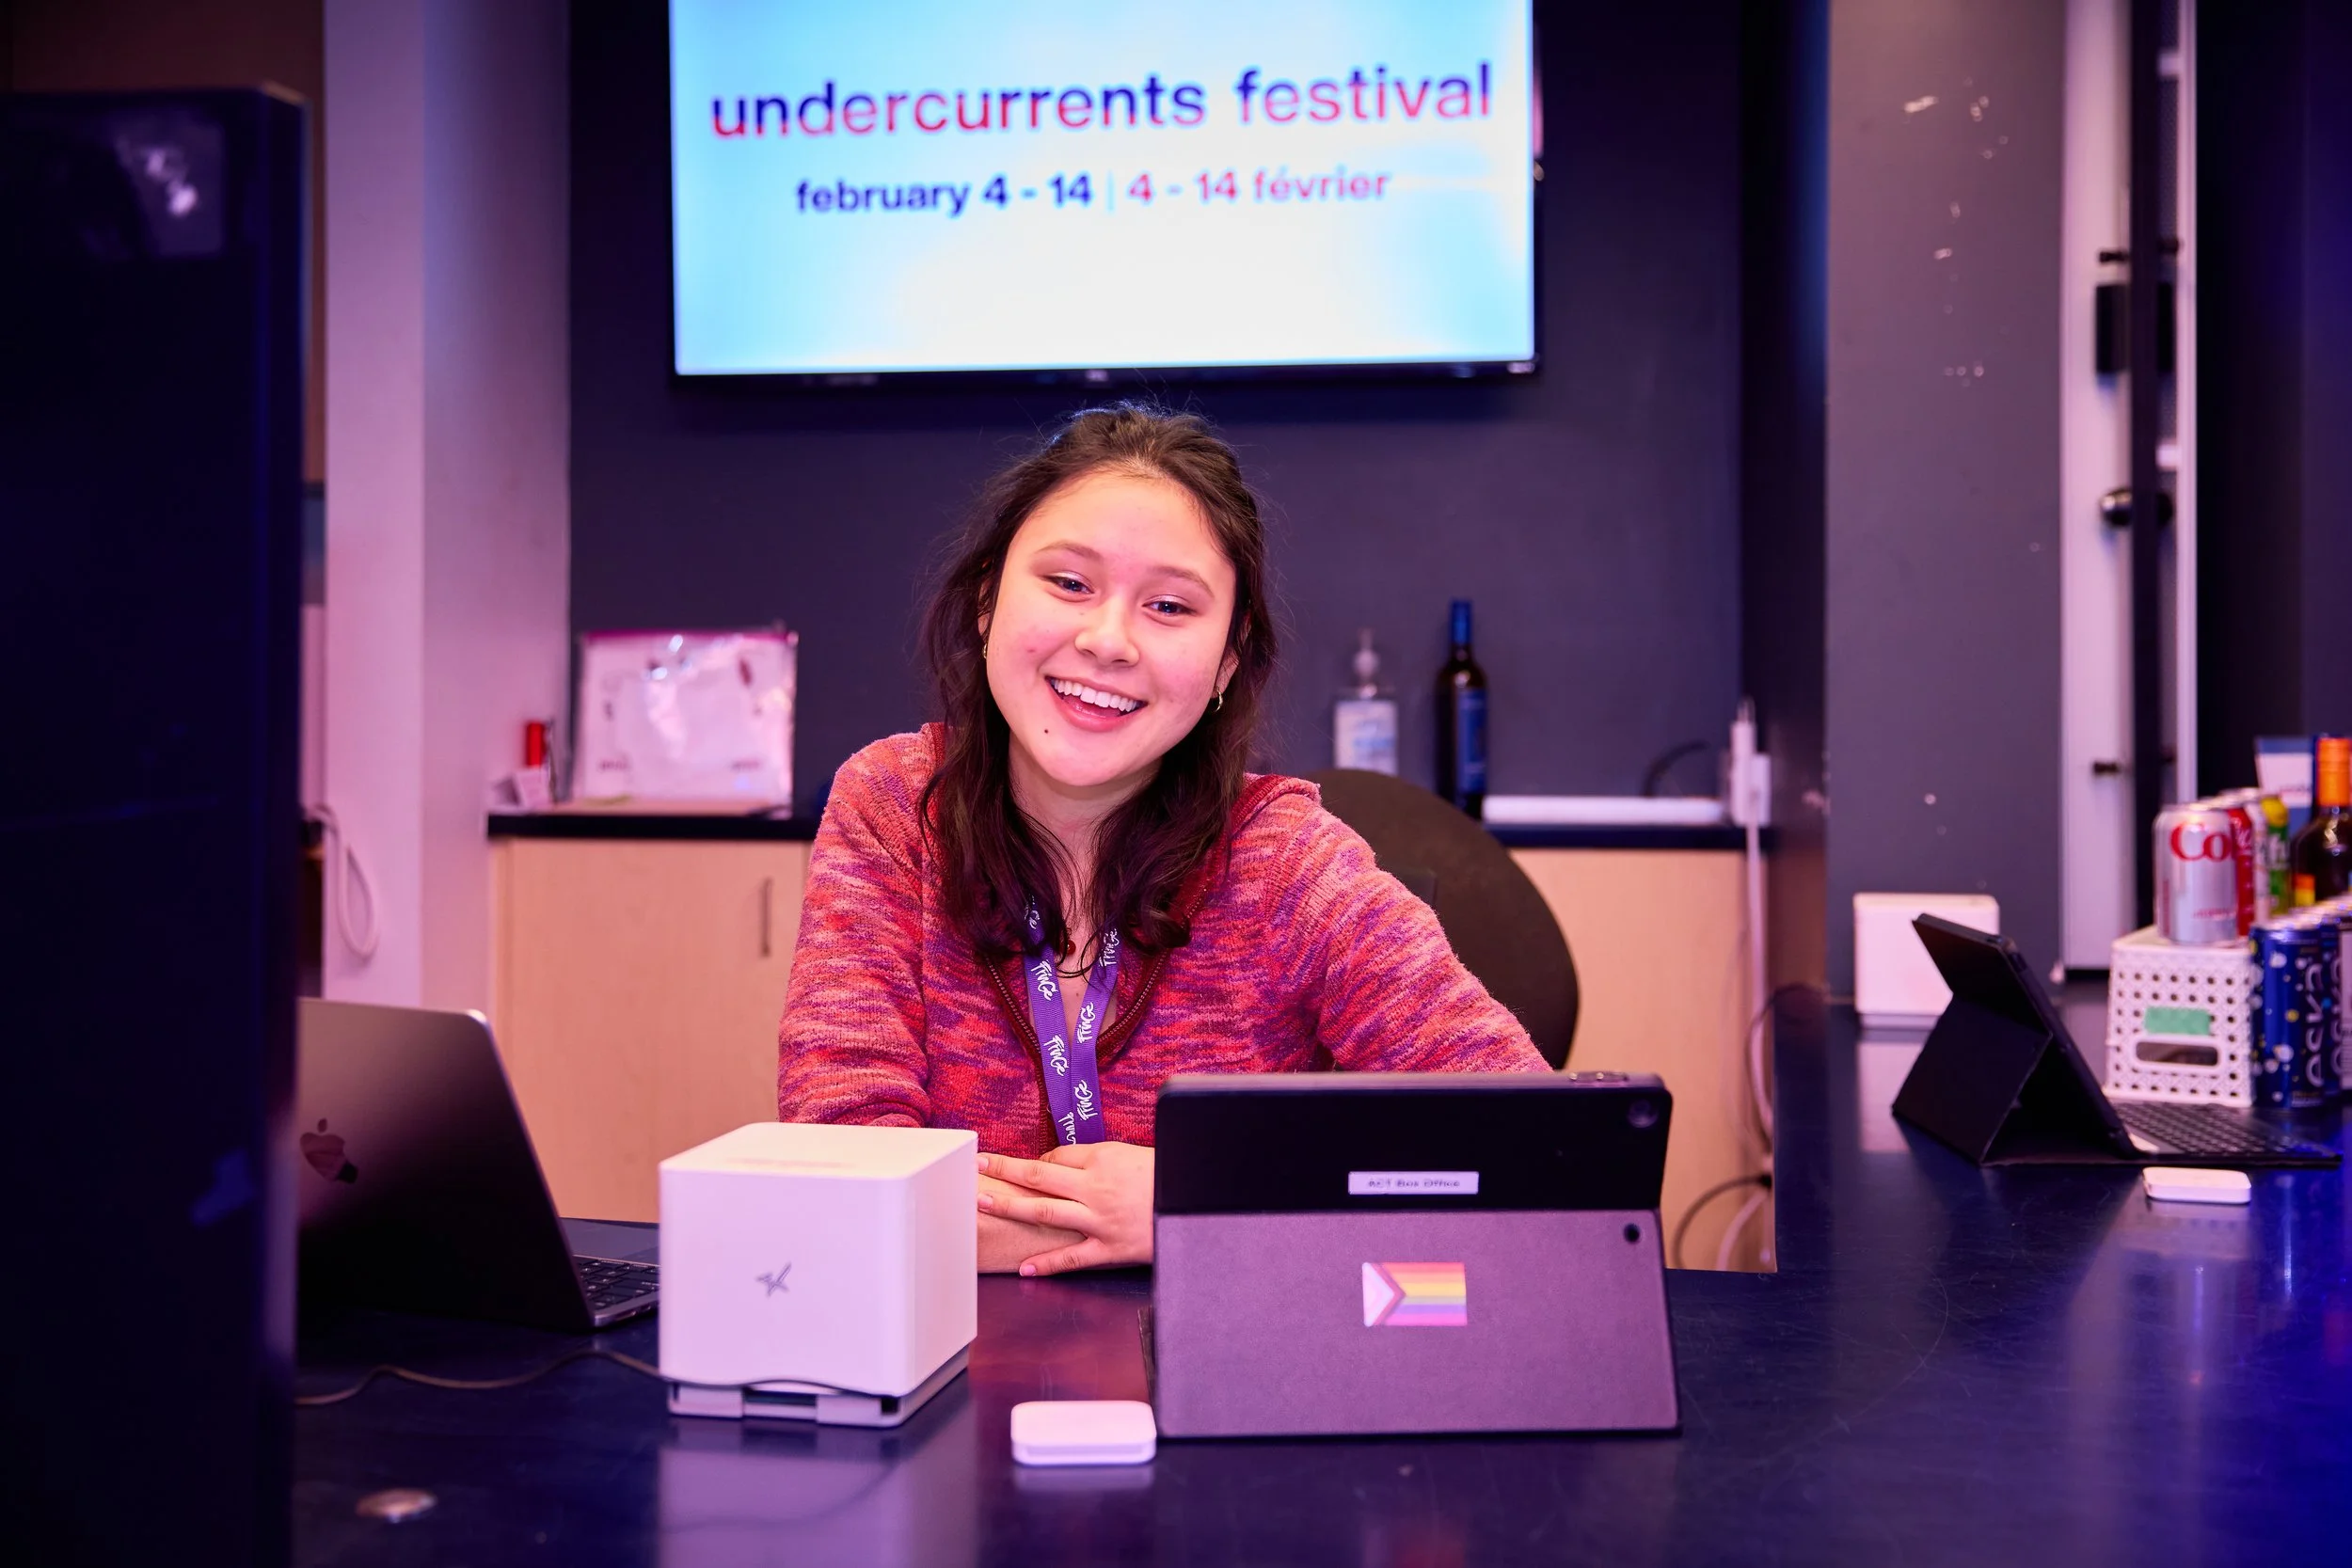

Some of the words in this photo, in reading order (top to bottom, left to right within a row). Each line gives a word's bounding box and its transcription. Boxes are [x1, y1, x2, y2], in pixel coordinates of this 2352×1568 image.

[712, 77, 1207, 136] undercurrents
[1236, 61, 1490, 123] festival
[796, 177, 970, 217] february
[982, 174, 1009, 207] 4
[1050, 172, 1092, 207] 14
[1128, 172, 1154, 202] 4
[1196, 170, 1239, 201] 14
[1253, 164, 1391, 202] février
[2169, 820, 2233, 863] Co
